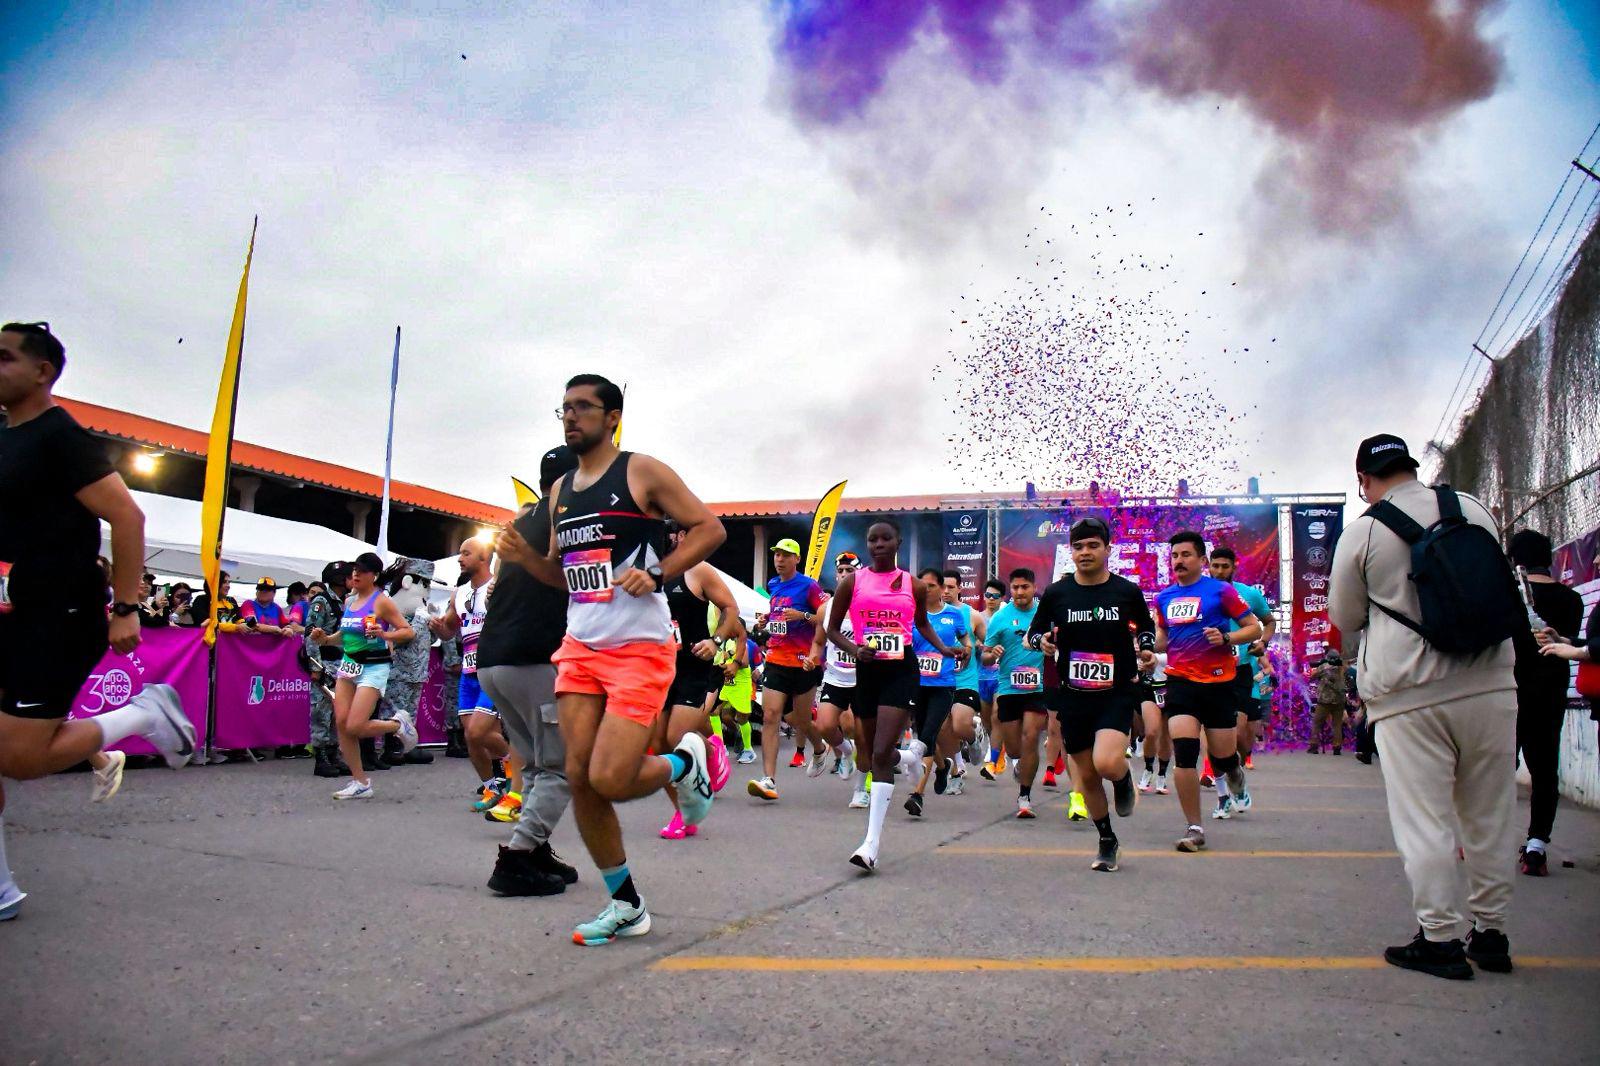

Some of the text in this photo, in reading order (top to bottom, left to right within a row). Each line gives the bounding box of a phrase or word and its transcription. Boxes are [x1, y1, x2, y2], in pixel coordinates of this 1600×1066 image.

[567, 564, 609, 592] 0001
[860, 610, 902, 619] TEAM
[1171, 604, 1195, 618] 1231
[1012, 672, 1038, 685] 1064
[1073, 662, 1110, 681] 1029
